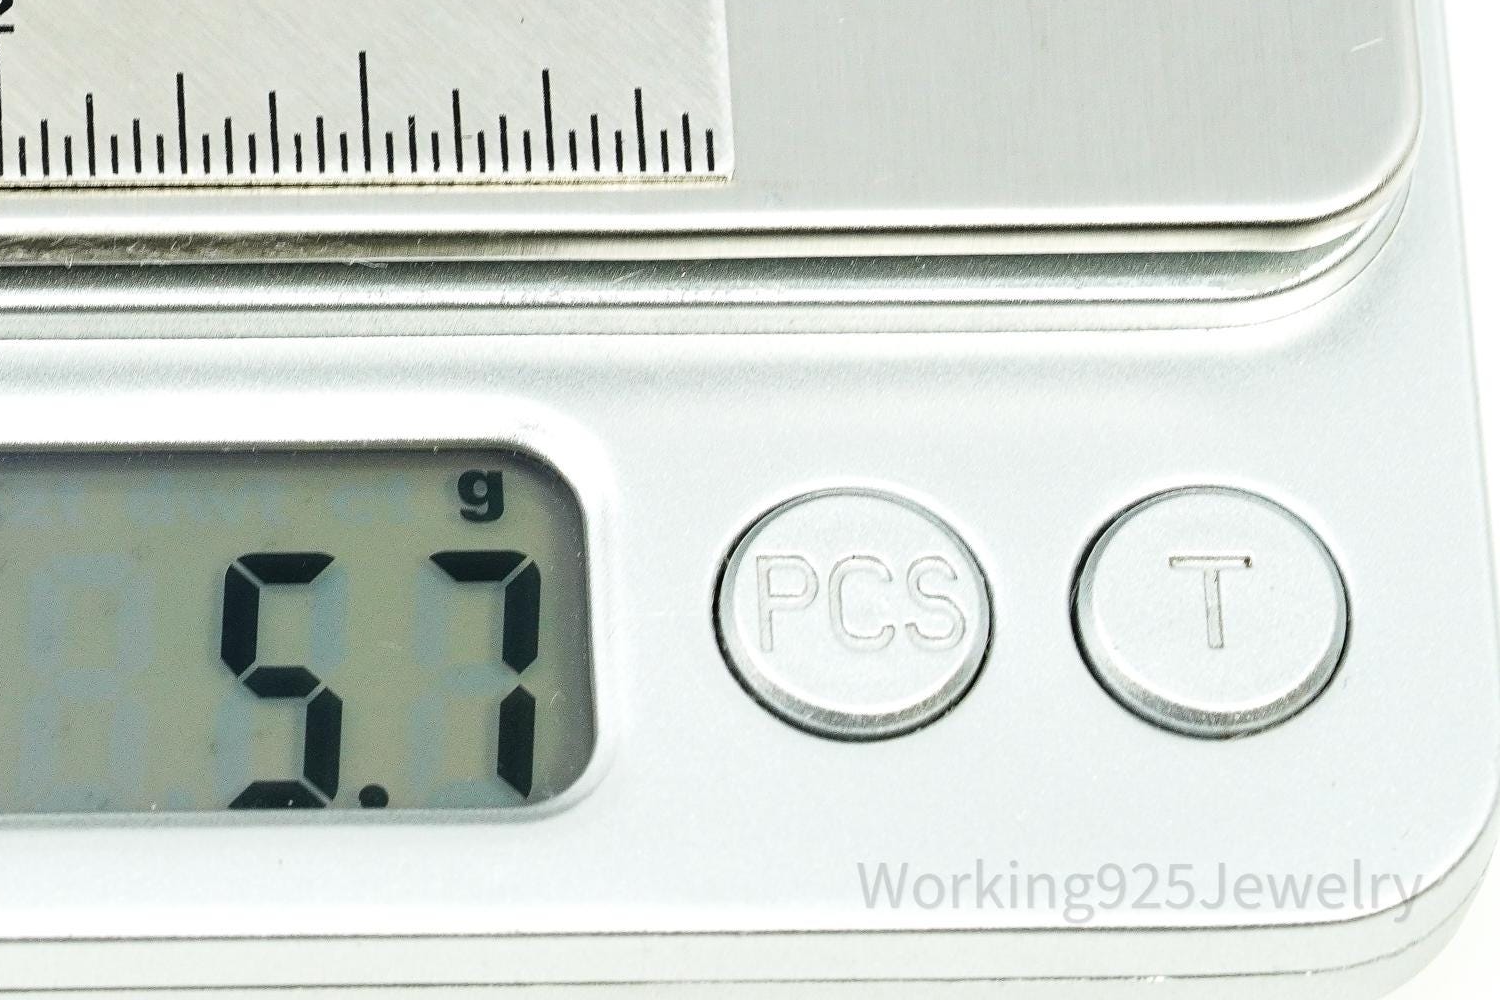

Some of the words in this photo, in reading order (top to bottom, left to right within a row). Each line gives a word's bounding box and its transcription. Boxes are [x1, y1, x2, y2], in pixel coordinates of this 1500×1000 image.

[457, 468, 506, 523] g
[756, 554, 966, 652] PCS
[1169, 554, 1253, 650] T
[219, 550, 542, 809] 5.7
